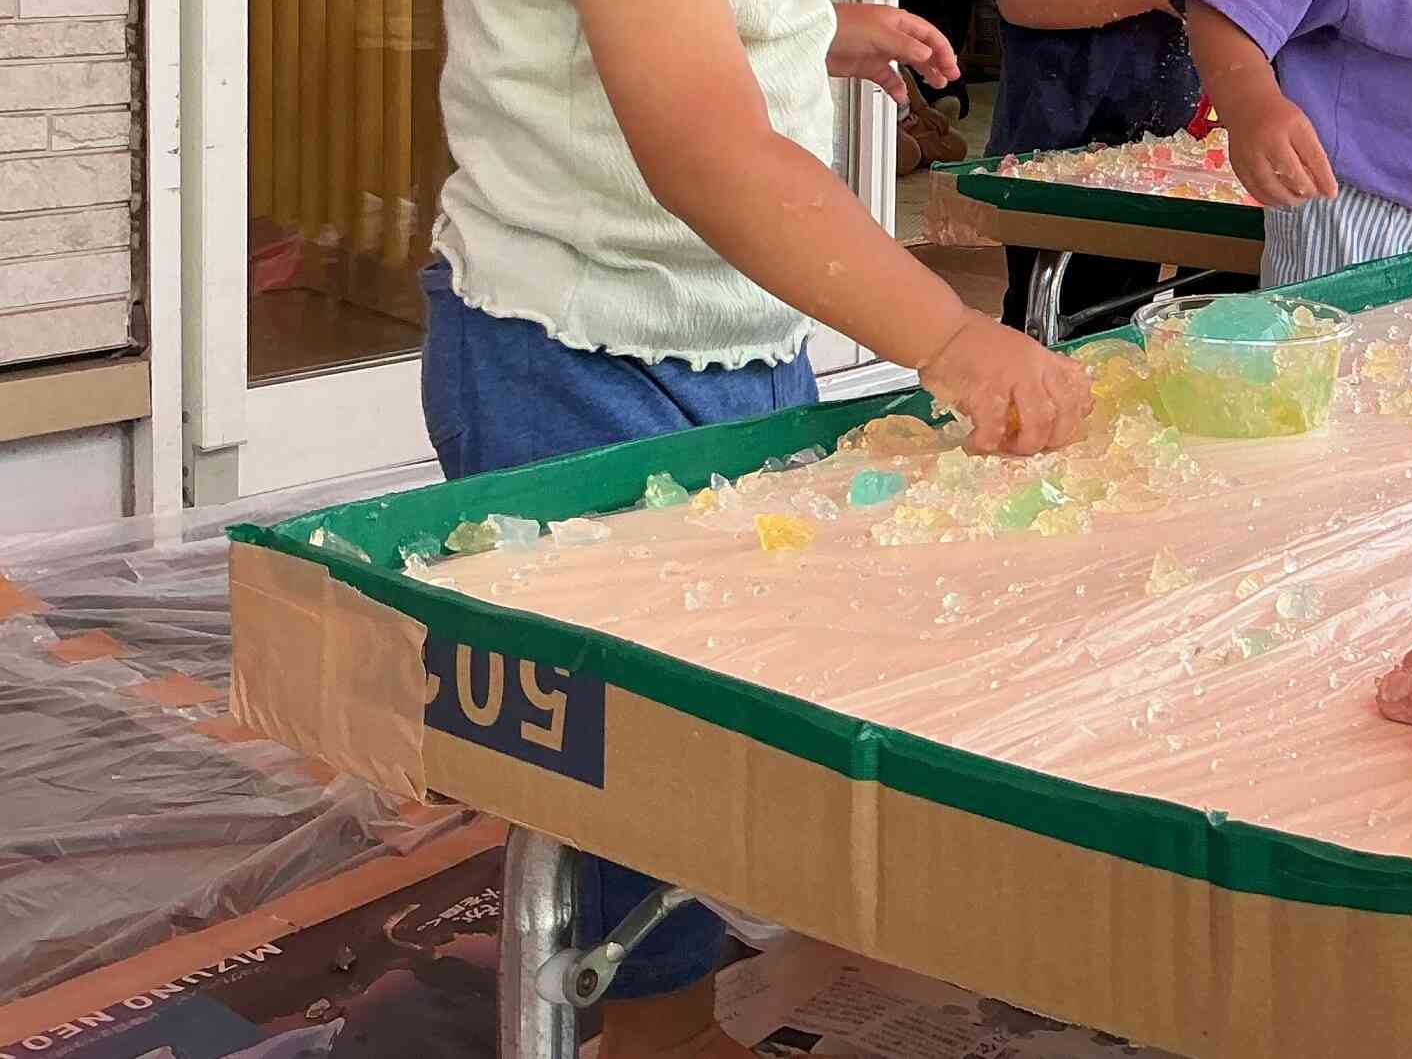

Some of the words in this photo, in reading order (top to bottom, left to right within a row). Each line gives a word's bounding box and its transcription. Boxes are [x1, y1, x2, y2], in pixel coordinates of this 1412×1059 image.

[425, 643, 570, 752] 50
[122, 942, 283, 1011] MIZUNO
[21, 1010, 116, 1051] NEO
